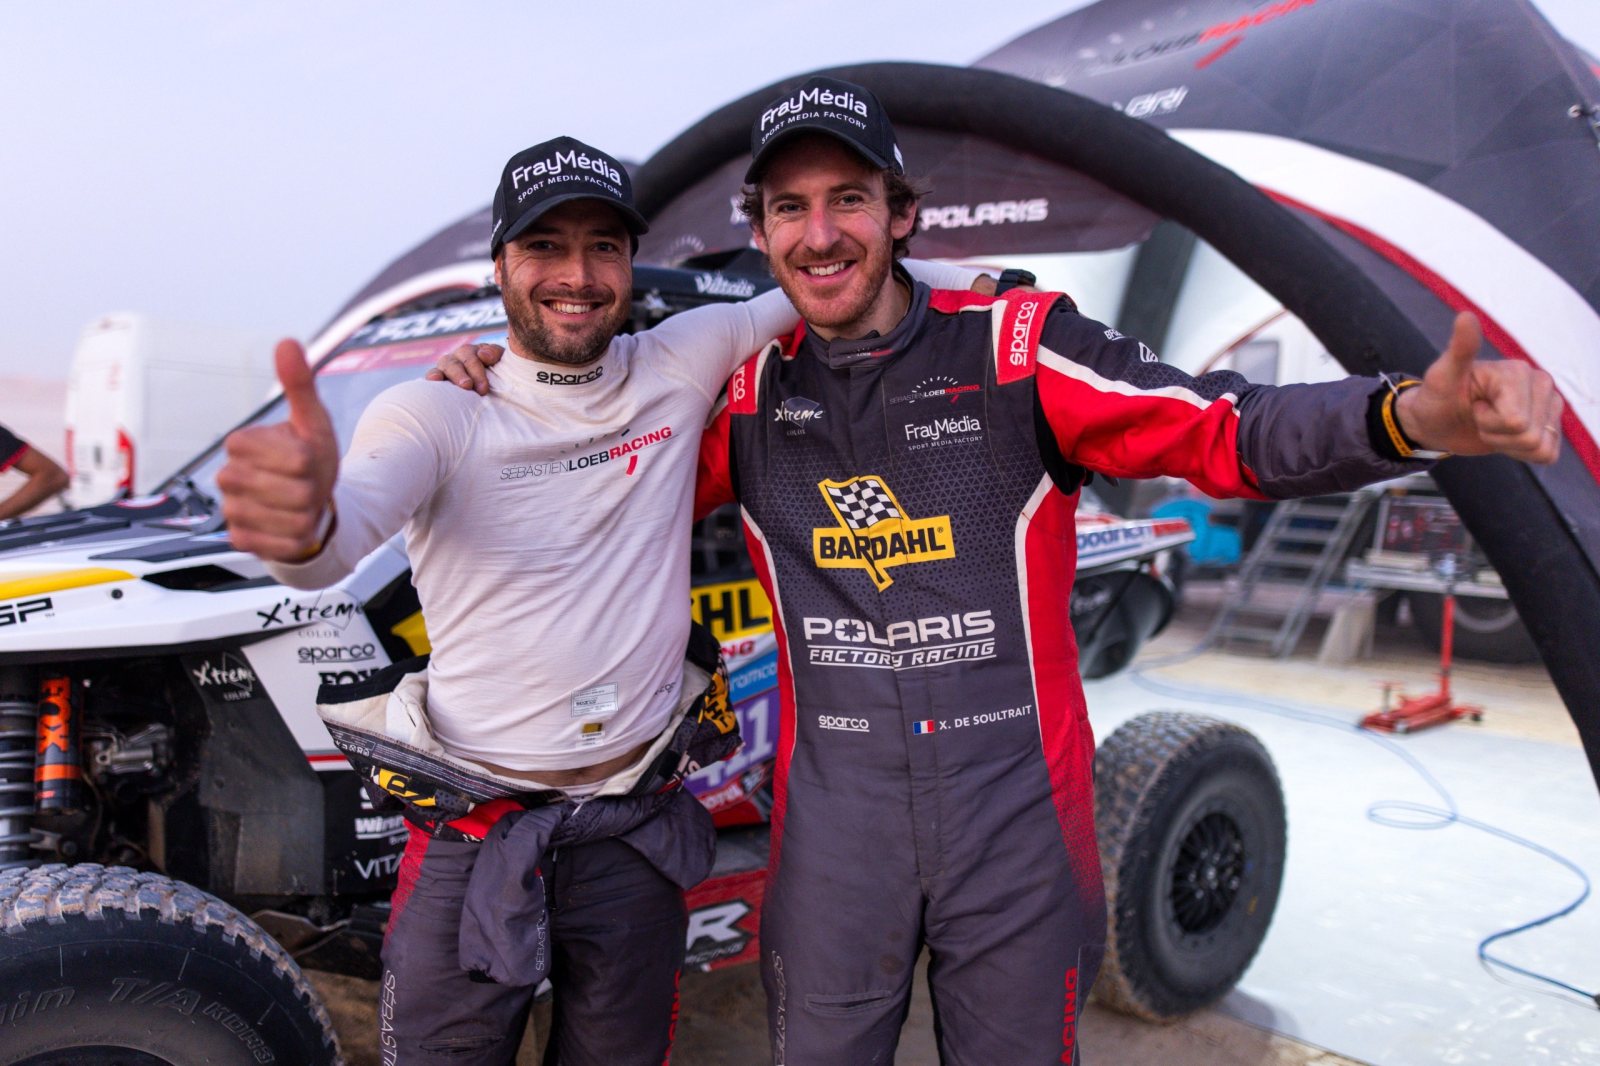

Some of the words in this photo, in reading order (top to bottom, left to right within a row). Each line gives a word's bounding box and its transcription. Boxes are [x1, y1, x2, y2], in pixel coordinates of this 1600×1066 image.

[760, 87, 868, 131] FrayMédia
[761, 121, 785, 144] SPORT
[787, 112, 820, 123] MEDIA
[823, 111, 867, 130] FACTORY
[512, 150, 622, 189] FrayMédia
[517, 181, 545, 203] SPORT
[547, 174, 581, 185] MEDIA
[584, 175, 623, 198] FACTORY
[921, 198, 1048, 231] POLARIS
[1010, 302, 1037, 366] sparco
[536, 366, 603, 386] sparco
[904, 415, 982, 440] FrayMédia
[908, 443, 929, 451] SPORT
[954, 436, 983, 444] FACTORY
[298, 630, 340, 638] COLOR
[803, 610, 996, 646] POLARIS
[298, 642, 376, 664] sparco
[809, 650, 903, 667] FACTORY
[911, 641, 996, 666] RACING
[818, 715, 869, 732] sparco
[939, 720, 951, 730] X.
[954, 717, 970, 728] DE
[973, 705, 1033, 725] SOULTRAIT
